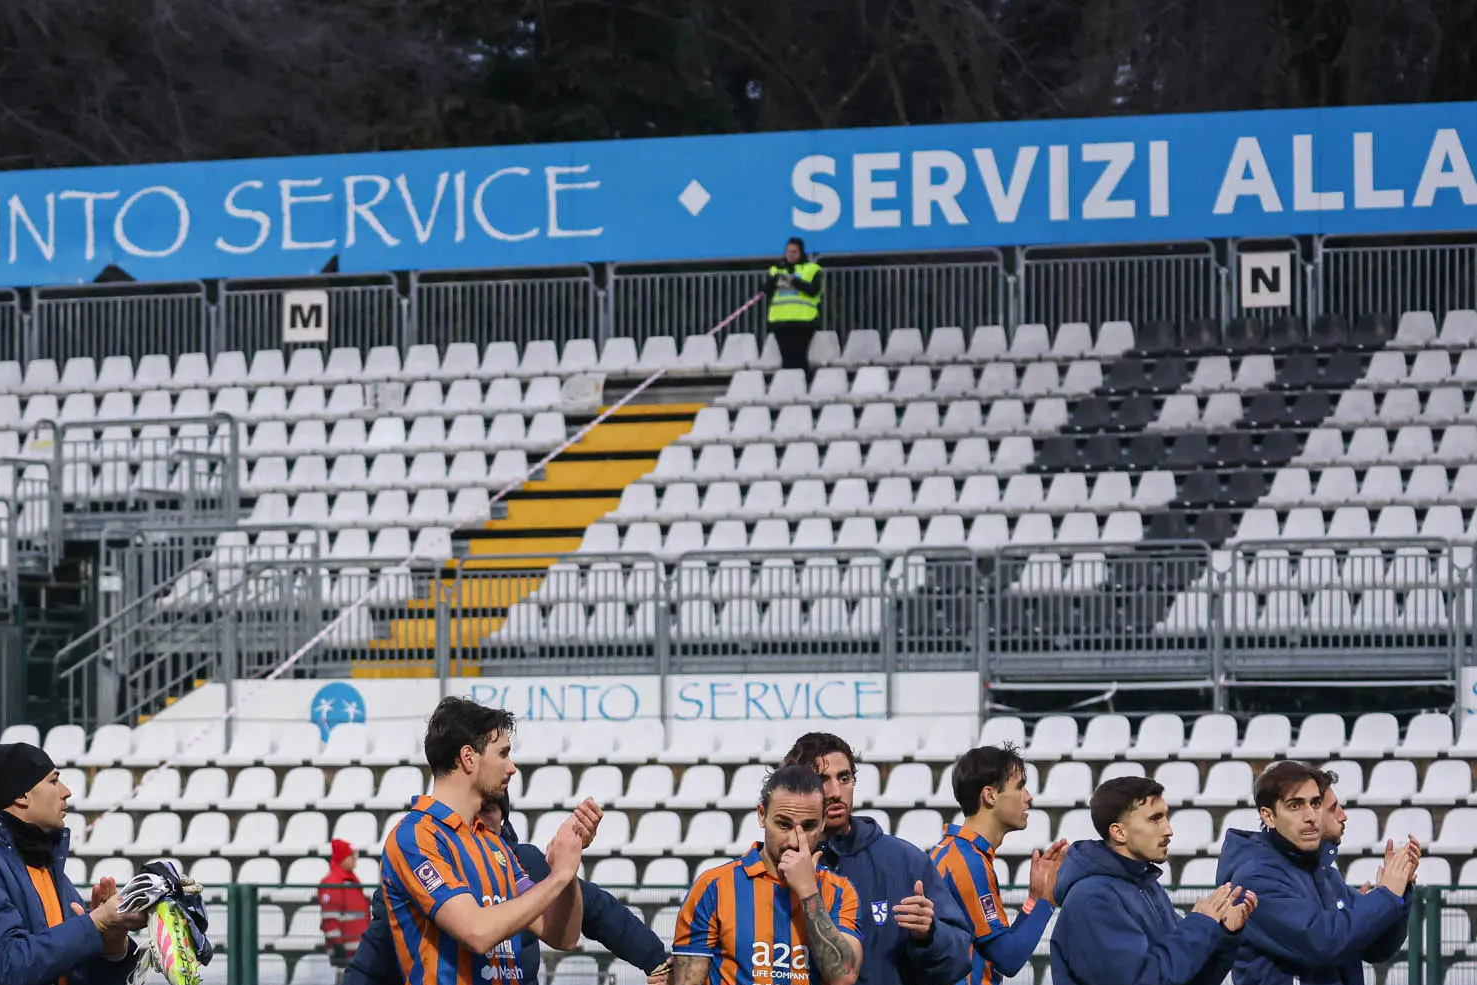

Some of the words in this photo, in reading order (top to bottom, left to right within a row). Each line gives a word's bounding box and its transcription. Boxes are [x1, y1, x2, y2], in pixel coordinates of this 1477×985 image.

[792, 141, 1170, 231] SERVIZI
[1213, 129, 1477, 214] ALLA
[216, 165, 605, 255] SERVICE
[1251, 266, 1281, 294] N
[289, 304, 323, 329] M
[674, 680, 885, 722] SERVICE
[751, 941, 811, 971] a2a
[752, 970, 769, 978] LIFE
[770, 970, 811, 981] COMPANY
